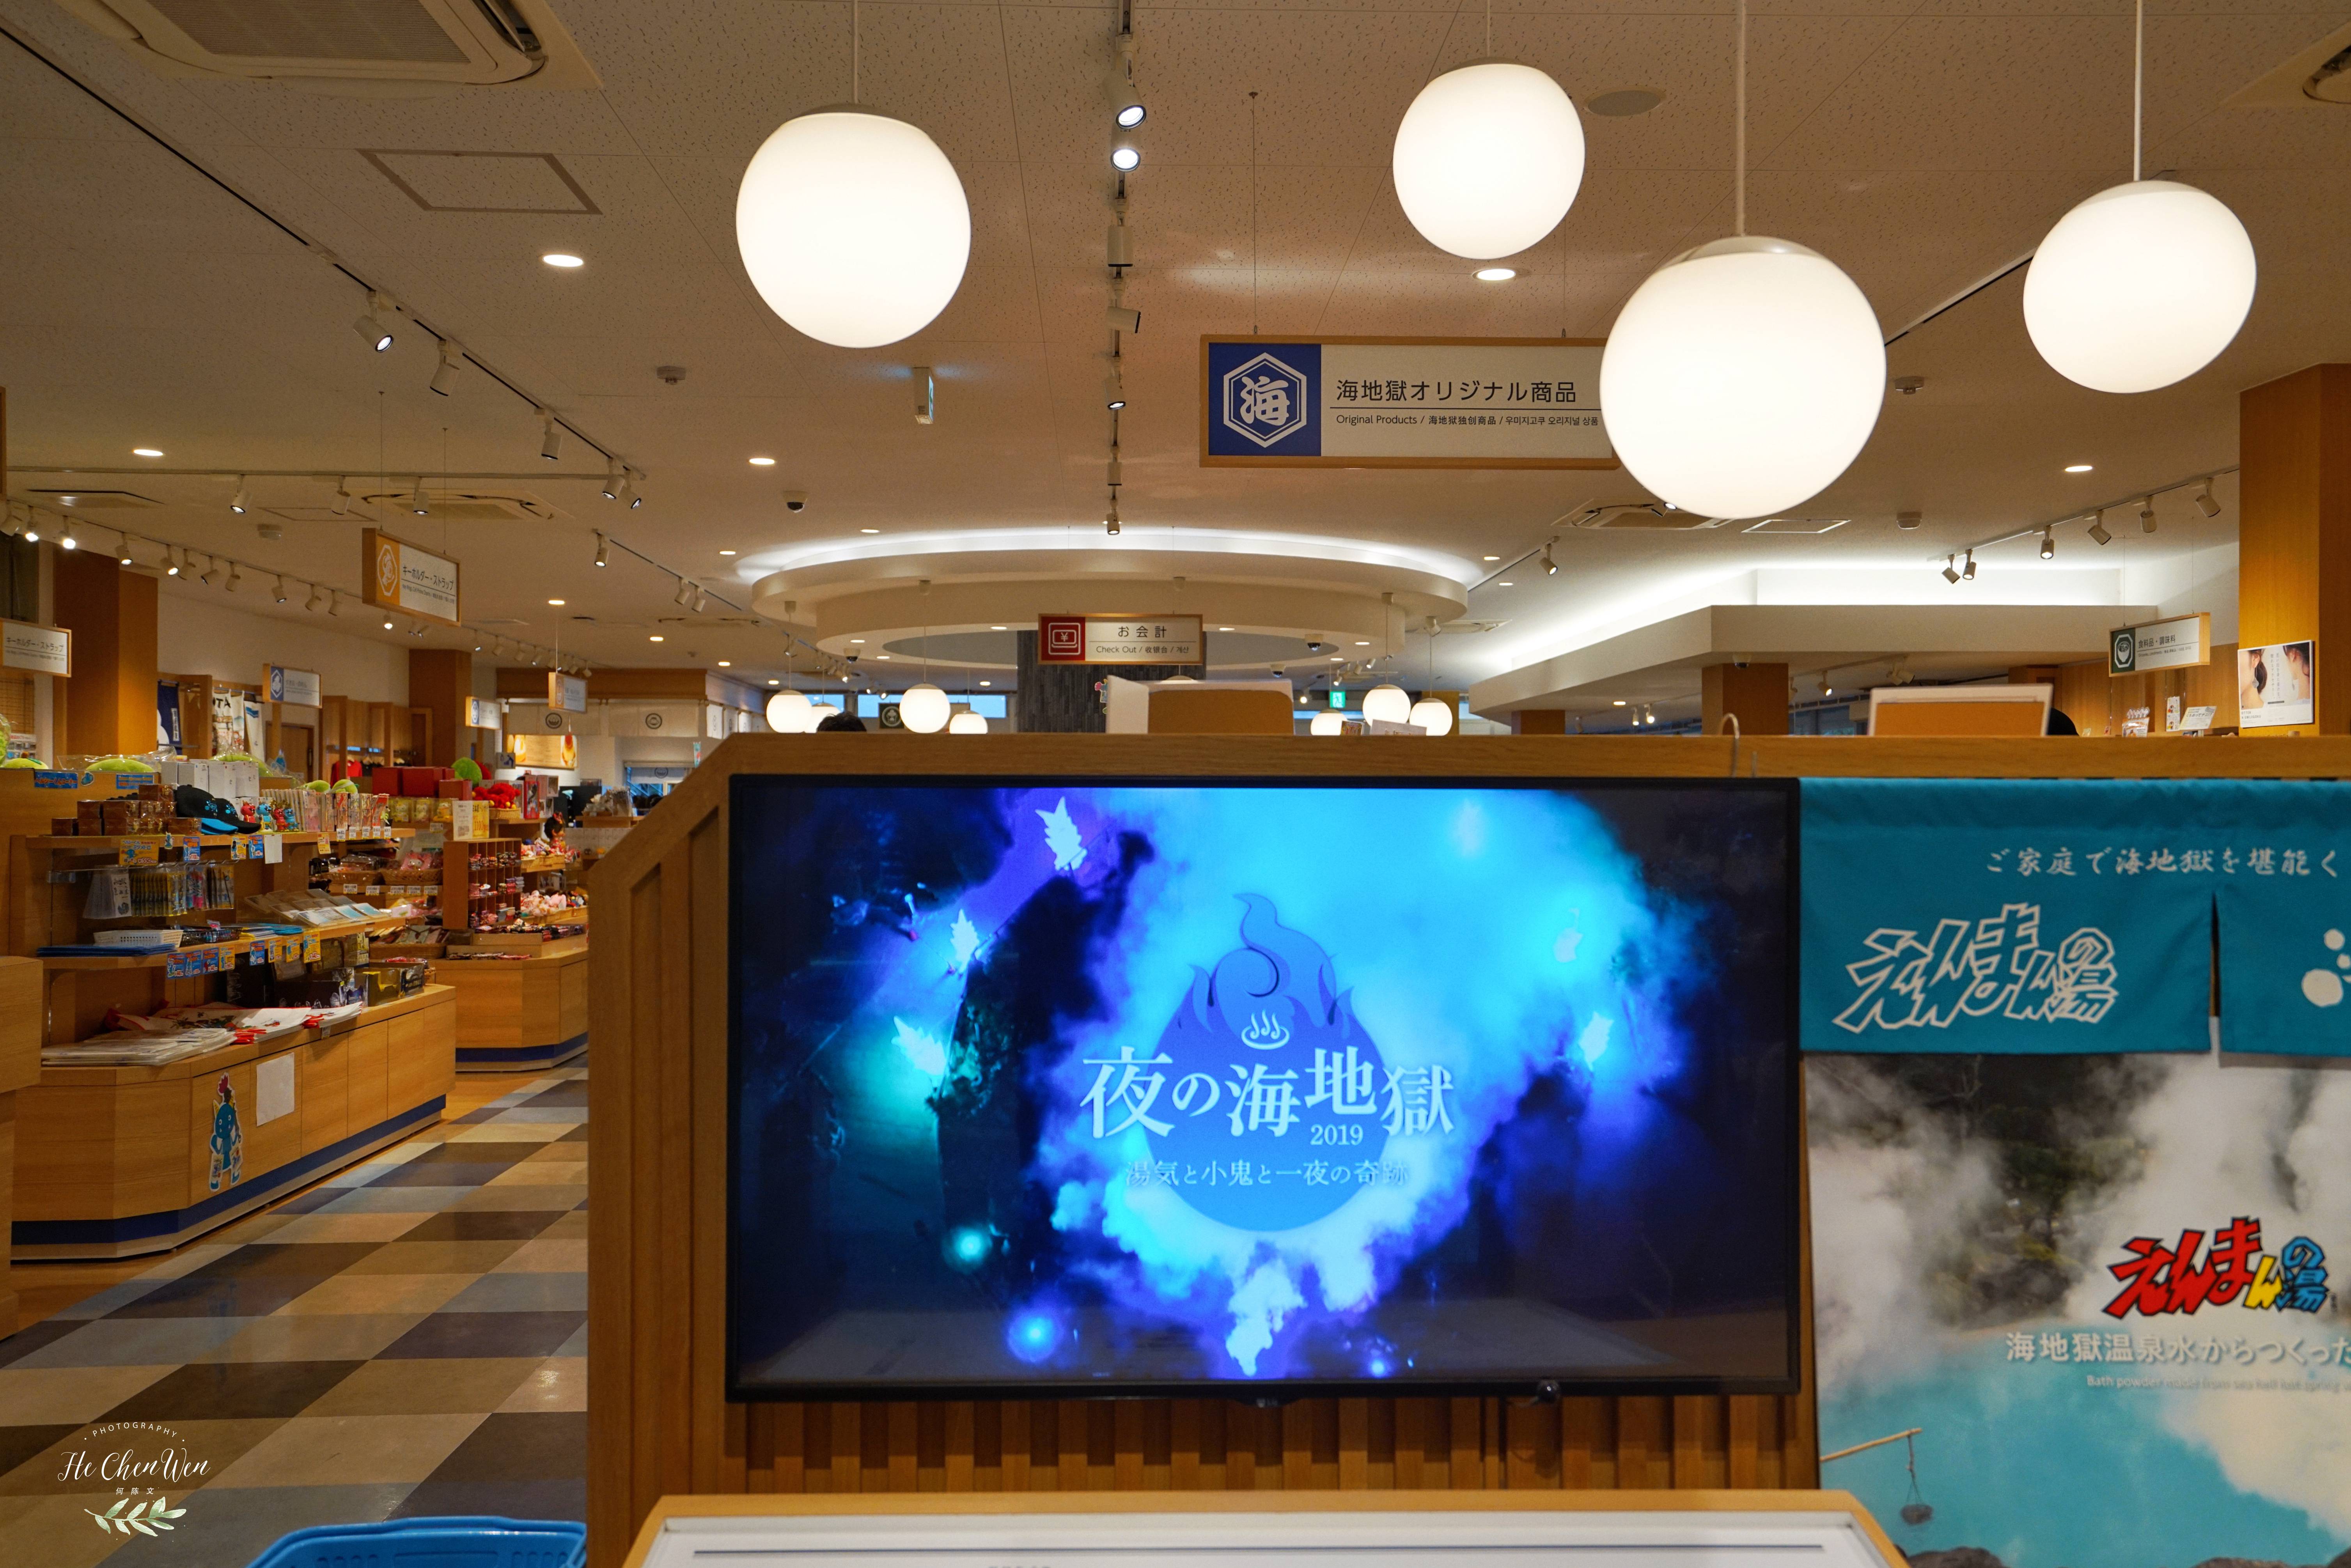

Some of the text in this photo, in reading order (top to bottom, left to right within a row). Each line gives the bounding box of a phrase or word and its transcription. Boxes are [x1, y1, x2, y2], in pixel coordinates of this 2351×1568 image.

[1336, 380, 1576, 403] 海地獄オリジナル商品
[1337, 415, 1373, 426] Original
[1376, 415, 1417, 424] Products
[1429, 416, 1496, 425] 海地狱独创商品
[1505, 416, 1546, 425] 우미지고쿠
[1548, 416, 1580, 426] 오리지널
[1582, 416, 1599, 426] 상품
[402, 565, 454, 591] キーホルダー・ストラップ
[1118, 625, 1167, 638] お会計
[2138, 634, 2175, 649] 食料品・調味料
[1080, 1045, 1455, 1138] 夜の海地獄
[1310, 1125, 1363, 1145] 2019
[1125, 1160, 1410, 1187] 湯気と小鬼と一夜の奇跡
[2087, 1375, 2113, 1386] Bath
[2116, 1376, 2160, 1389] powder
